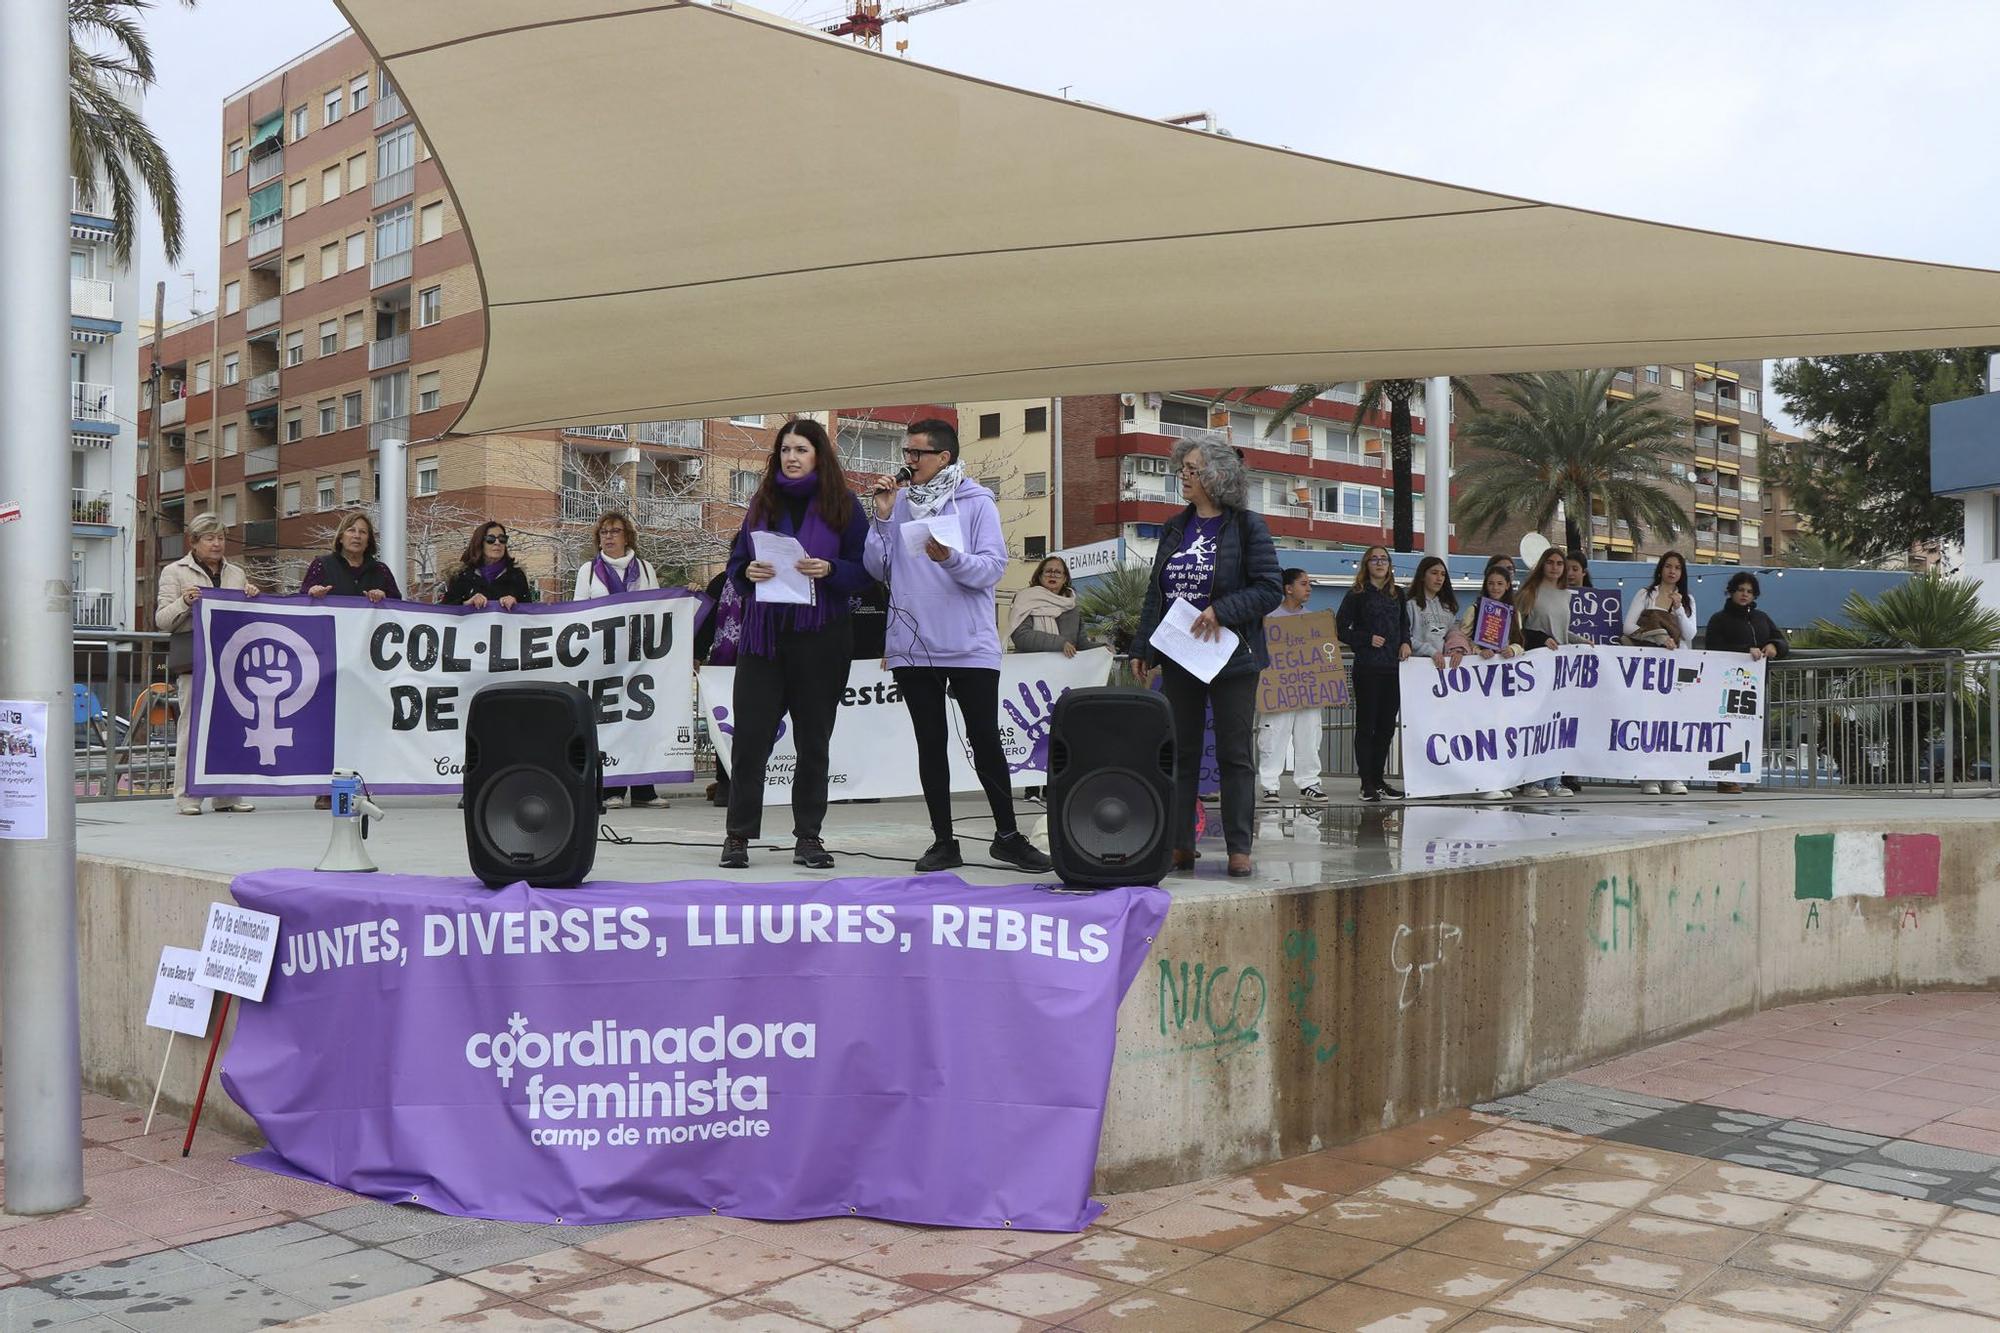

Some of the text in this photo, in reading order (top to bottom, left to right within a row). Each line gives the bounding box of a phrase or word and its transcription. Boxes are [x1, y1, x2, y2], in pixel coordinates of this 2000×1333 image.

[1066, 549, 1109, 570] ENAMAR
[1263, 679, 1349, 711] CABREADA
[1432, 654, 1676, 698] JOVES AMB VEU
[390, 685, 459, 732] DE
[1608, 718, 1731, 754] IGUALTAT
[212, 909, 226, 931] Por
[225, 912, 233, 932] la
[281, 902, 1110, 977] JUNTES, DIVERSES, LLIURES, REBELS
[1158, 958, 1267, 1036] NICO
[465, 1013, 817, 1074] coordinadora
[525, 1067, 768, 1120] feminista
[530, 1115, 771, 1151] camp de morvedre
